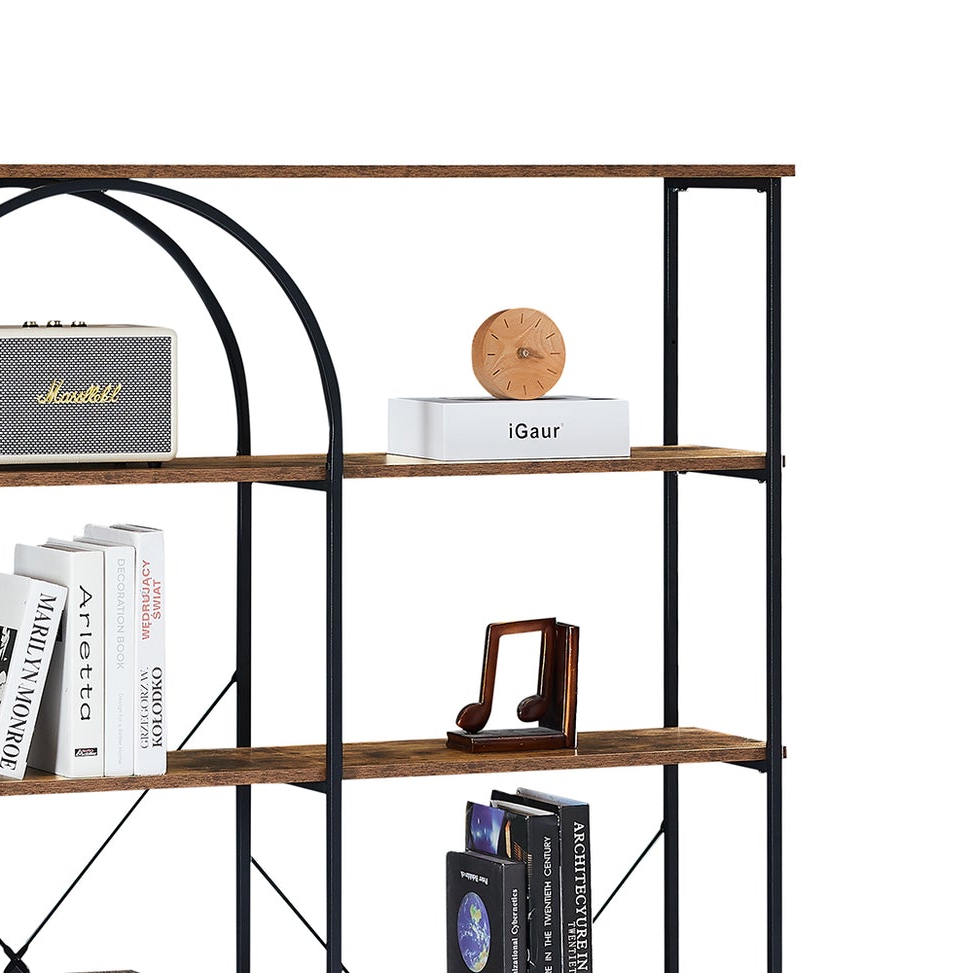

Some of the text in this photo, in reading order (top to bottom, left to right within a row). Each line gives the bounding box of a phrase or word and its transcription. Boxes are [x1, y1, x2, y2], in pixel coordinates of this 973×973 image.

[509, 423, 560, 439] iGaur
[116, 559, 126, 670] DECORATION BOOK
[152, 579, 162, 619] ŚWIAT
[0, 592, 57, 771] MARILYN MONROE
[140, 684, 149, 749] GRZEGORZ
[151, 667, 163, 747] KOŁODKO
[544, 836, 552, 877] CENTURY
[511, 889, 520, 935] Cybernetics
[544, 880, 552, 927] TWENTIETH
[545, 951, 552, 961] IN
[577, 951, 588, 970] IN
